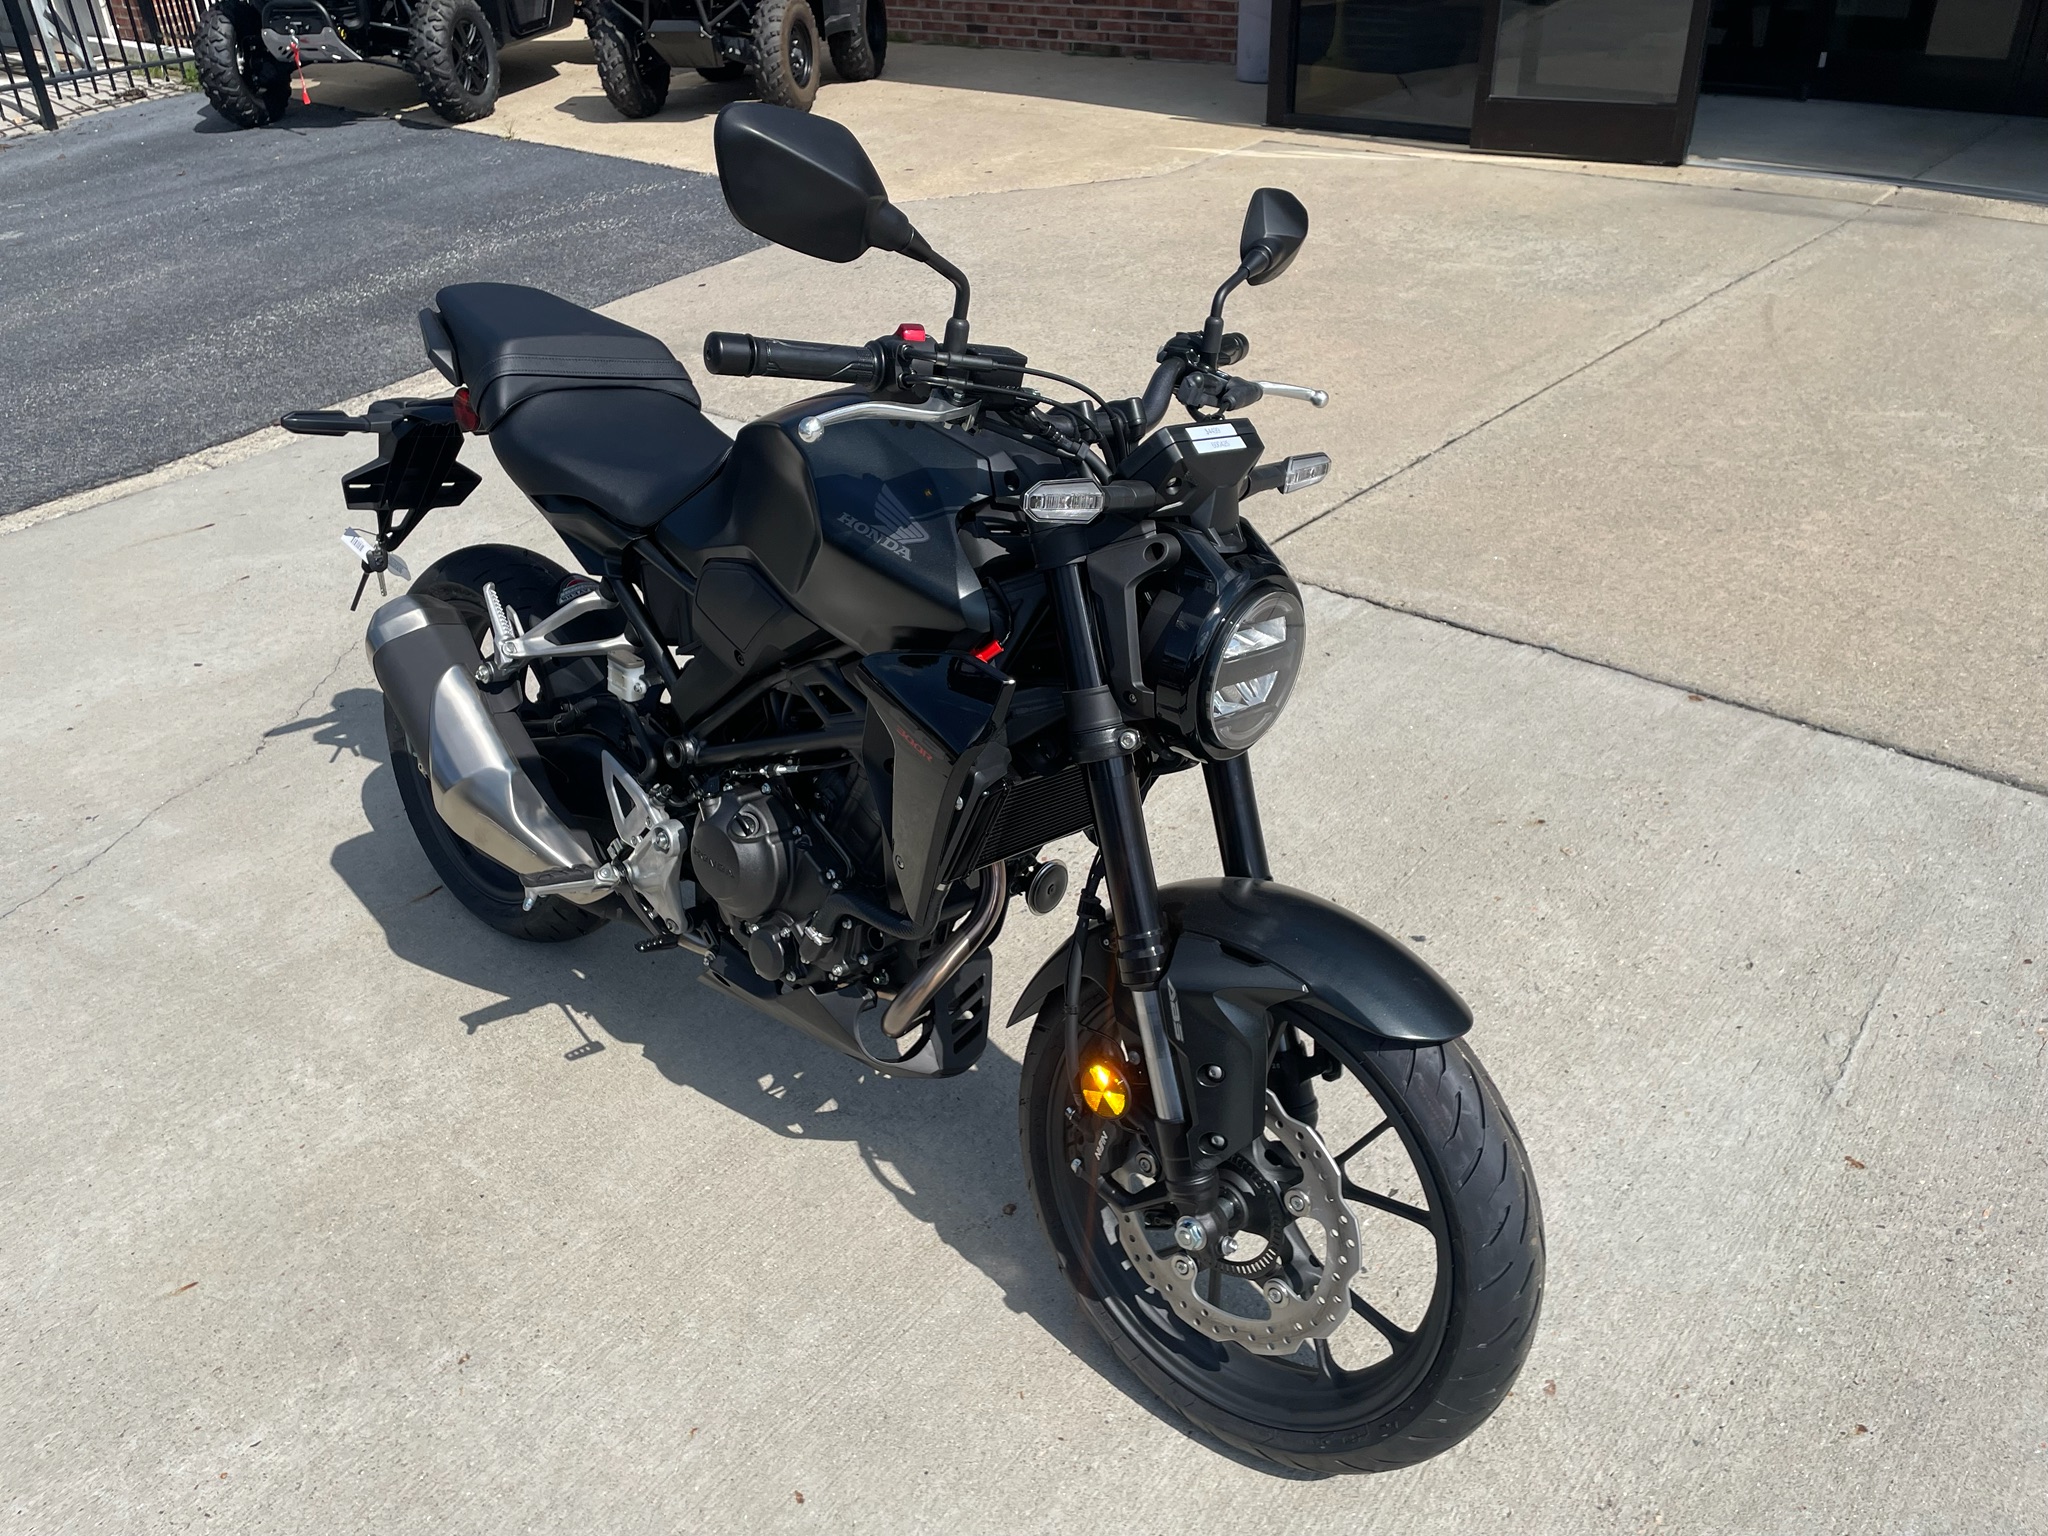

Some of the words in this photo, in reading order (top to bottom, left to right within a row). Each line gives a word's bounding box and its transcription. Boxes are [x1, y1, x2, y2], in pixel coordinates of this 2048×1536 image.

[837, 512, 912, 562] HONDA
[896, 725, 933, 762] 300R
[1167, 978, 1185, 1043] ABS
